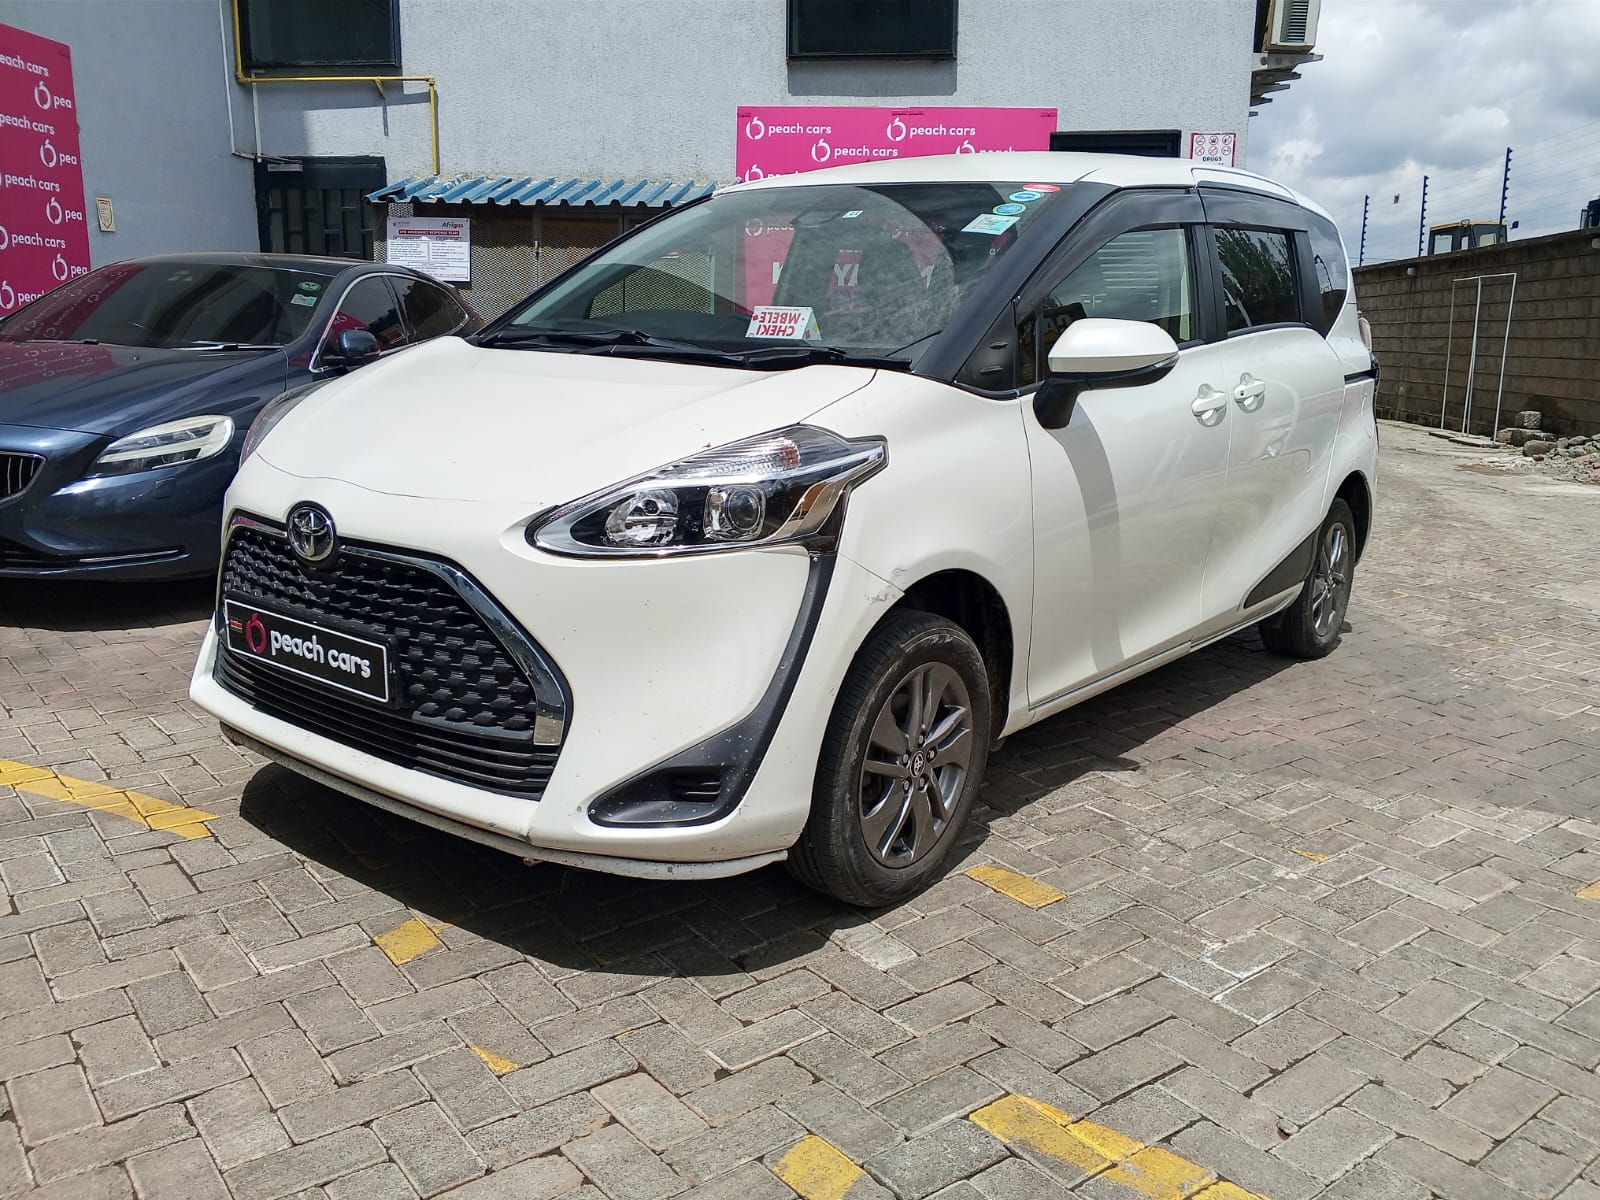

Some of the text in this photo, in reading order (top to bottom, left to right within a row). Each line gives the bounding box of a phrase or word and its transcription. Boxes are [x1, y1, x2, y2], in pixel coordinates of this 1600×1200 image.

[0, 54, 49, 77] each cars
[32, 122, 55, 135] cars
[768, 123, 832, 136] peach cars
[910, 125, 976, 138] peach cars
[834, 145, 898, 159] peach cars
[5, 174, 61, 192] peach cars
[441, 221, 464, 229] Afrigas
[11, 232, 66, 249] peach cars
[758, 312, 801, 324] MBELE
[756, 324, 796, 337] CHEKI
[270, 630, 372, 679] peach cars
